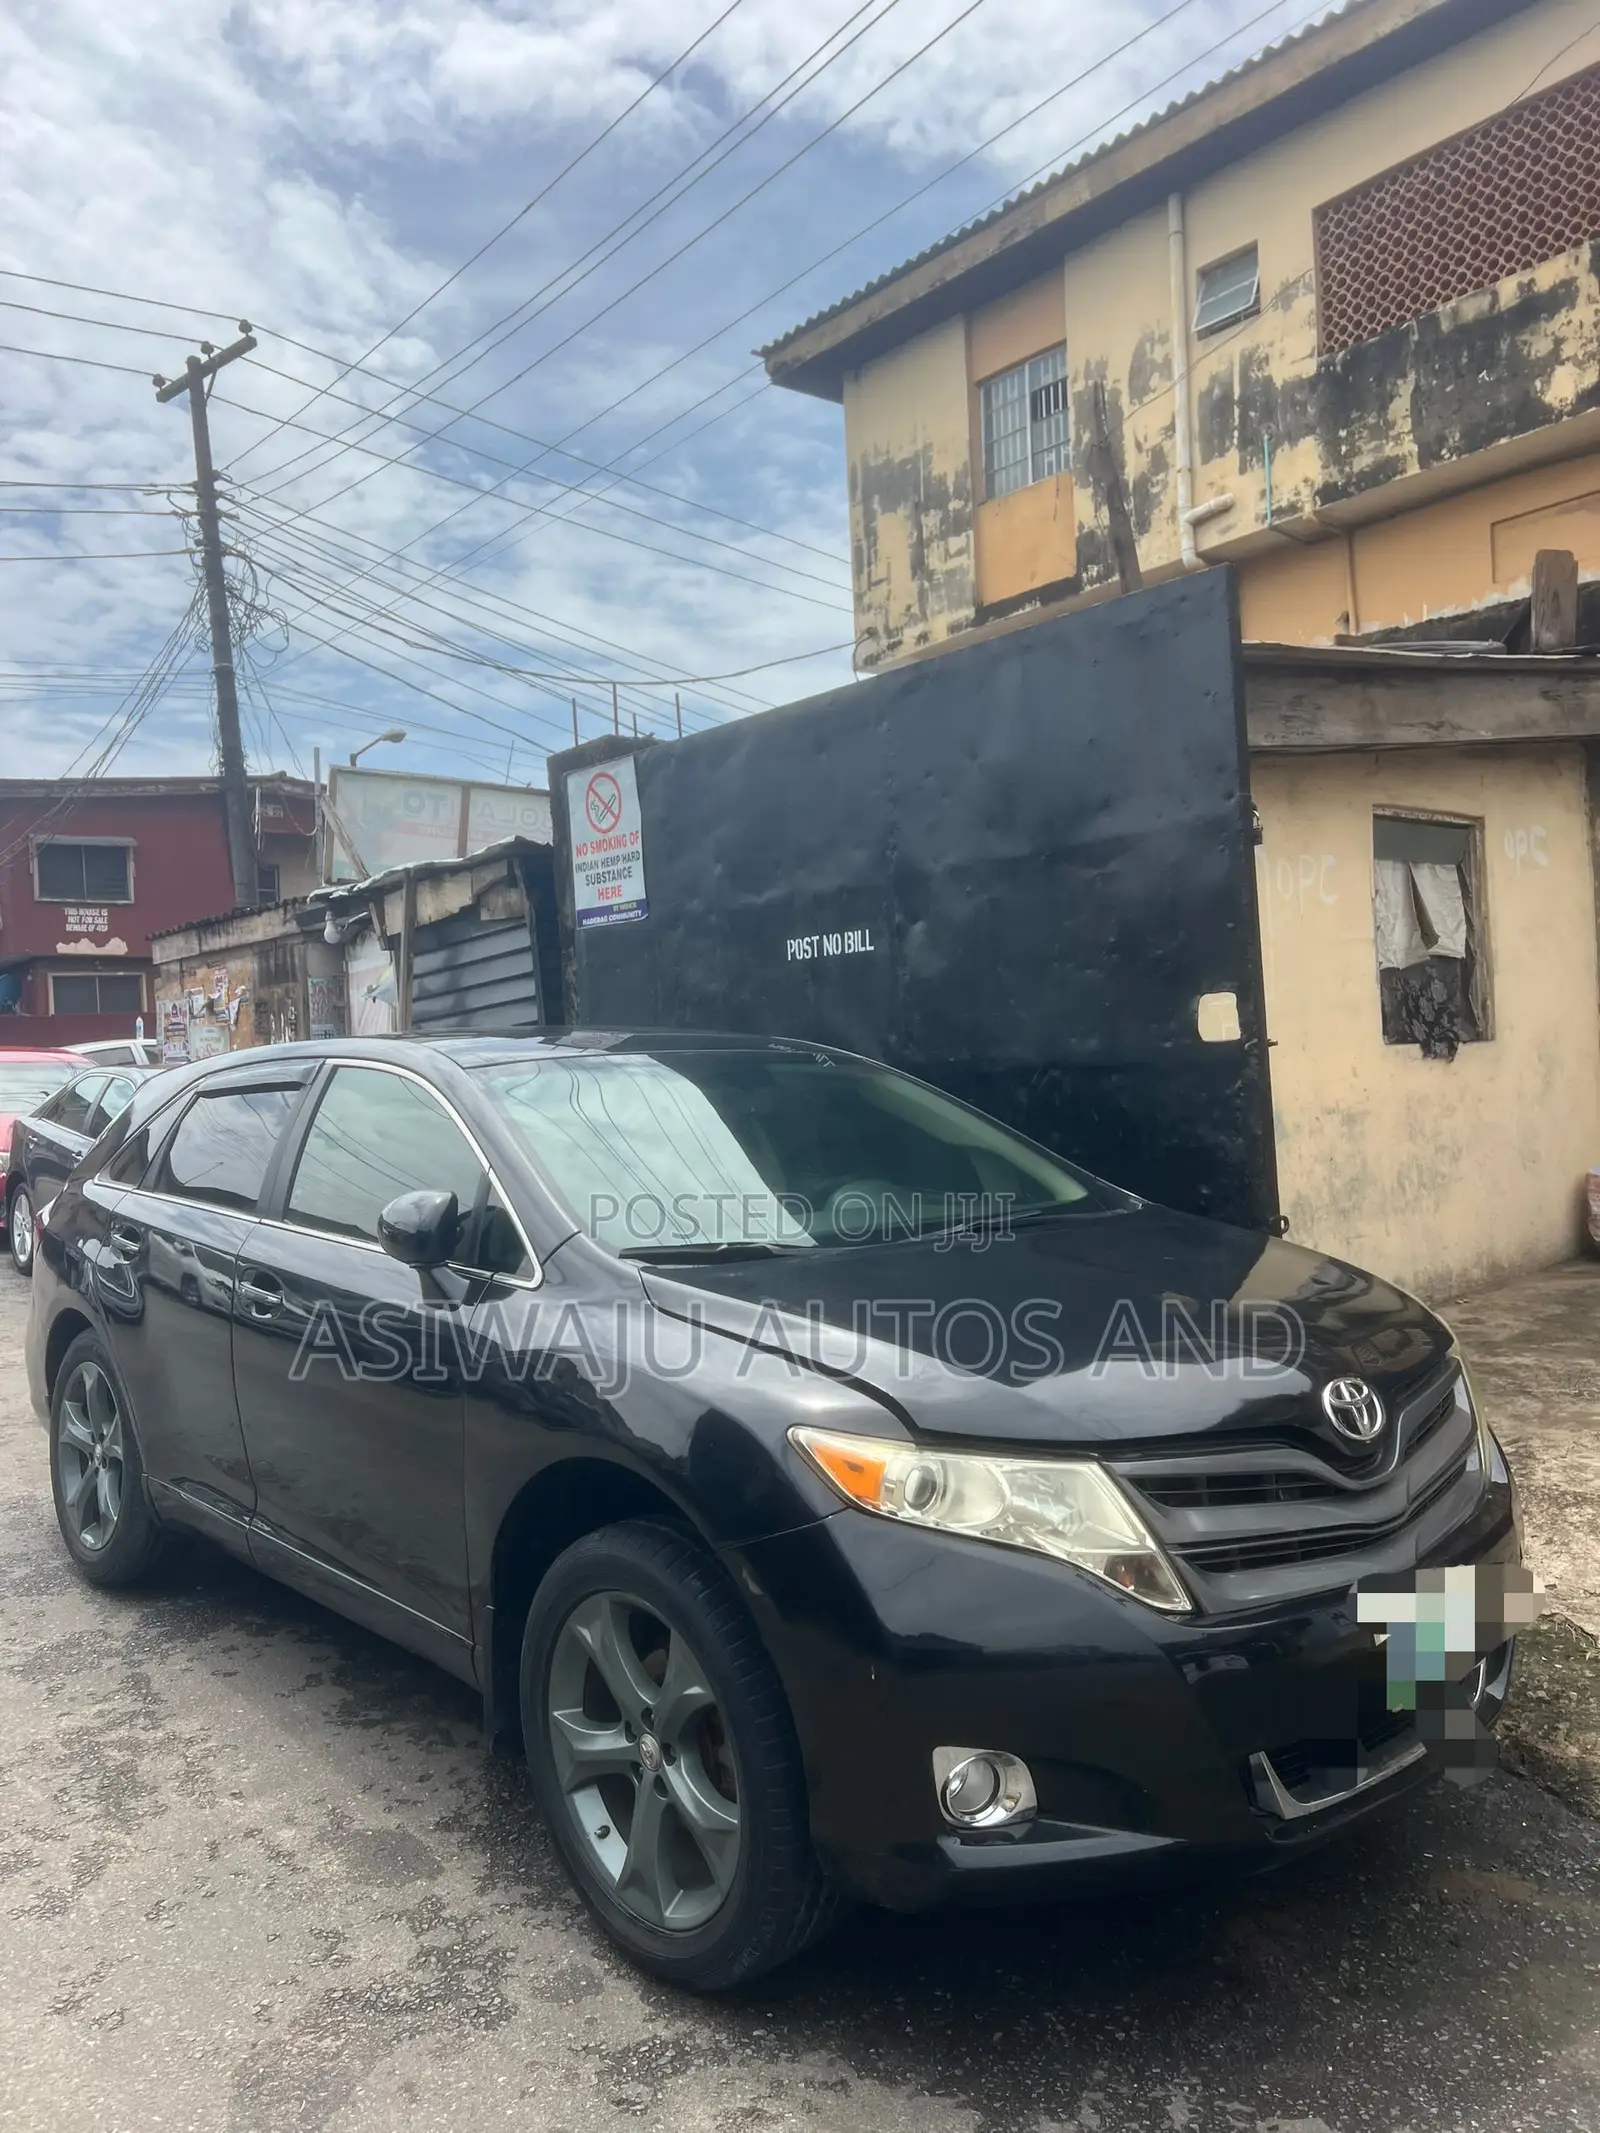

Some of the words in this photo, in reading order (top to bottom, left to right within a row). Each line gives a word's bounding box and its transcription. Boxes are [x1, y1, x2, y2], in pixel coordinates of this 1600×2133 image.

[576, 843, 588, 857] NO
[590, 834, 627, 855] SMOKING
[629, 830, 639, 846] OF
[575, 860, 599, 873] INDIAN
[600, 855, 620, 869] HEMP
[621, 850, 640, 864] HARD
[585, 866, 632, 887] SUBSTANCE
[597, 884, 622, 901] HERE
[608, 909, 642, 921] COMMUNITY
[787, 935, 819, 961] POST
[823, 932, 842, 957] NO
[844, 928, 875, 954] BILL
